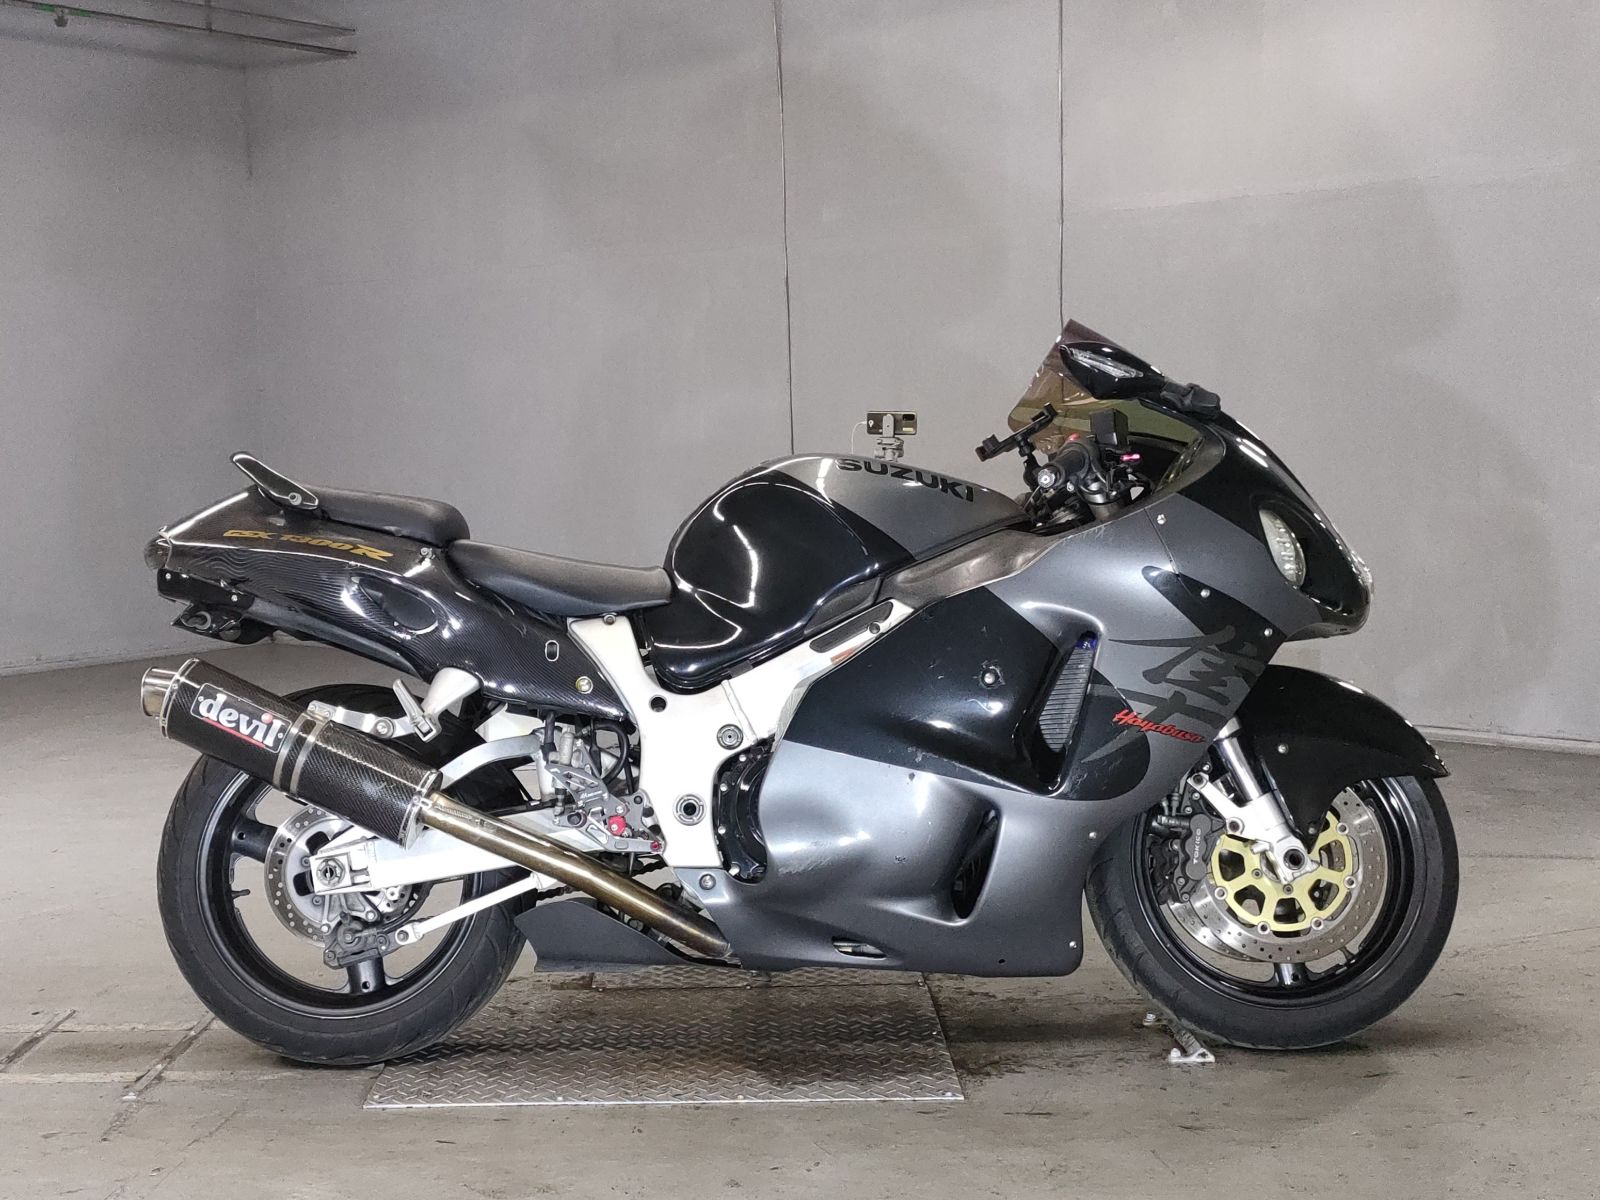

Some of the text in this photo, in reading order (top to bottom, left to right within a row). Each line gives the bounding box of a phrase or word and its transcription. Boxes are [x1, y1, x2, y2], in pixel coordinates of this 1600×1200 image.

[835, 457, 974, 502] SUZUKI
[198, 693, 286, 747] devil
[1111, 708, 1206, 744] Hayabusa
[1192, 828, 1202, 865] TOKICO
